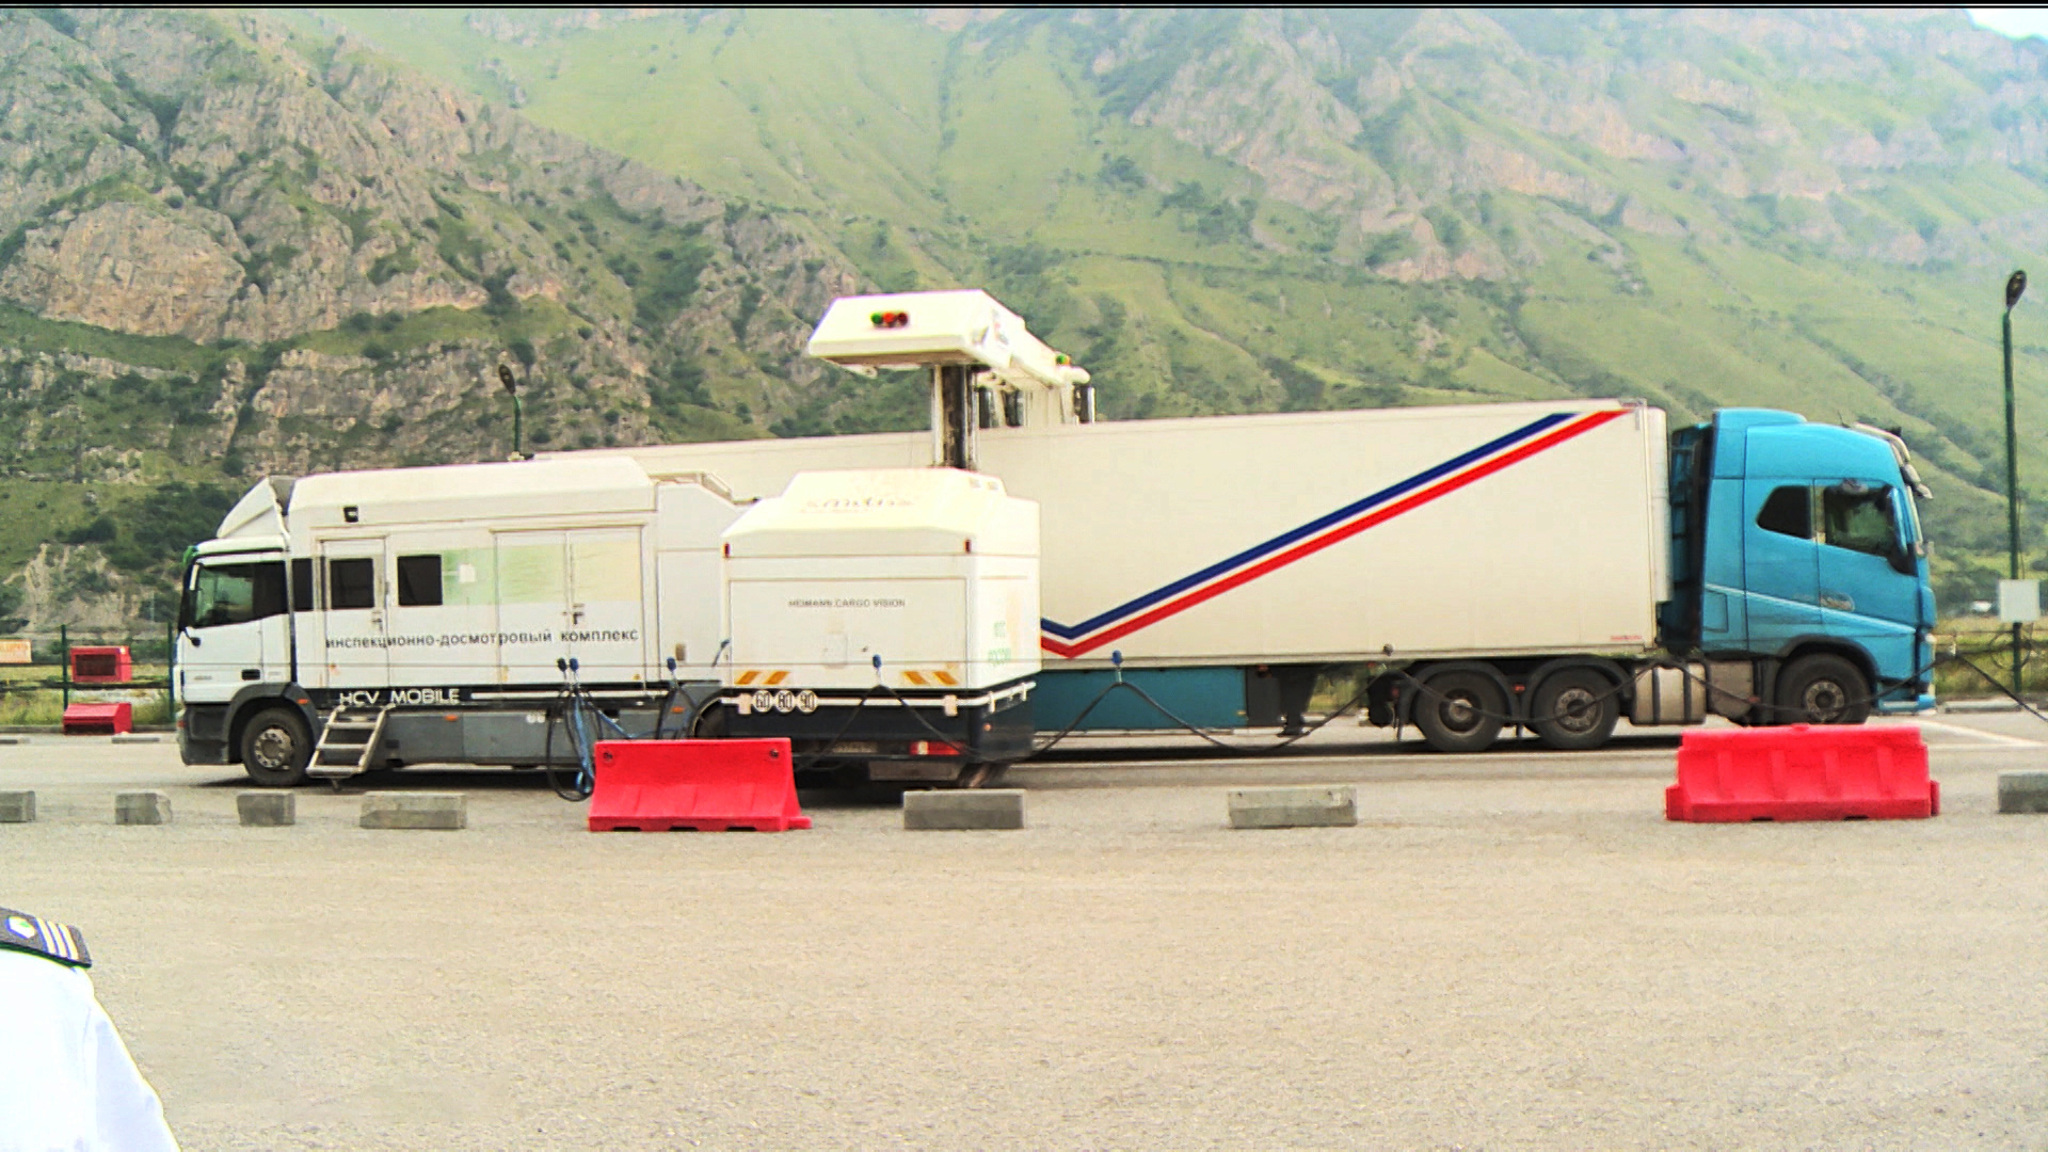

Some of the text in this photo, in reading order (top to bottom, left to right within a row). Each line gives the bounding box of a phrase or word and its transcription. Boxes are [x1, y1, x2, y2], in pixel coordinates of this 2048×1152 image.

[834, 598, 871, 608] CARGO
[872, 598, 906, 608] VISION
[325, 628, 640, 649] инспекционно-досмотровый комплекс
[339, 688, 460, 704] HCV MOBILE
